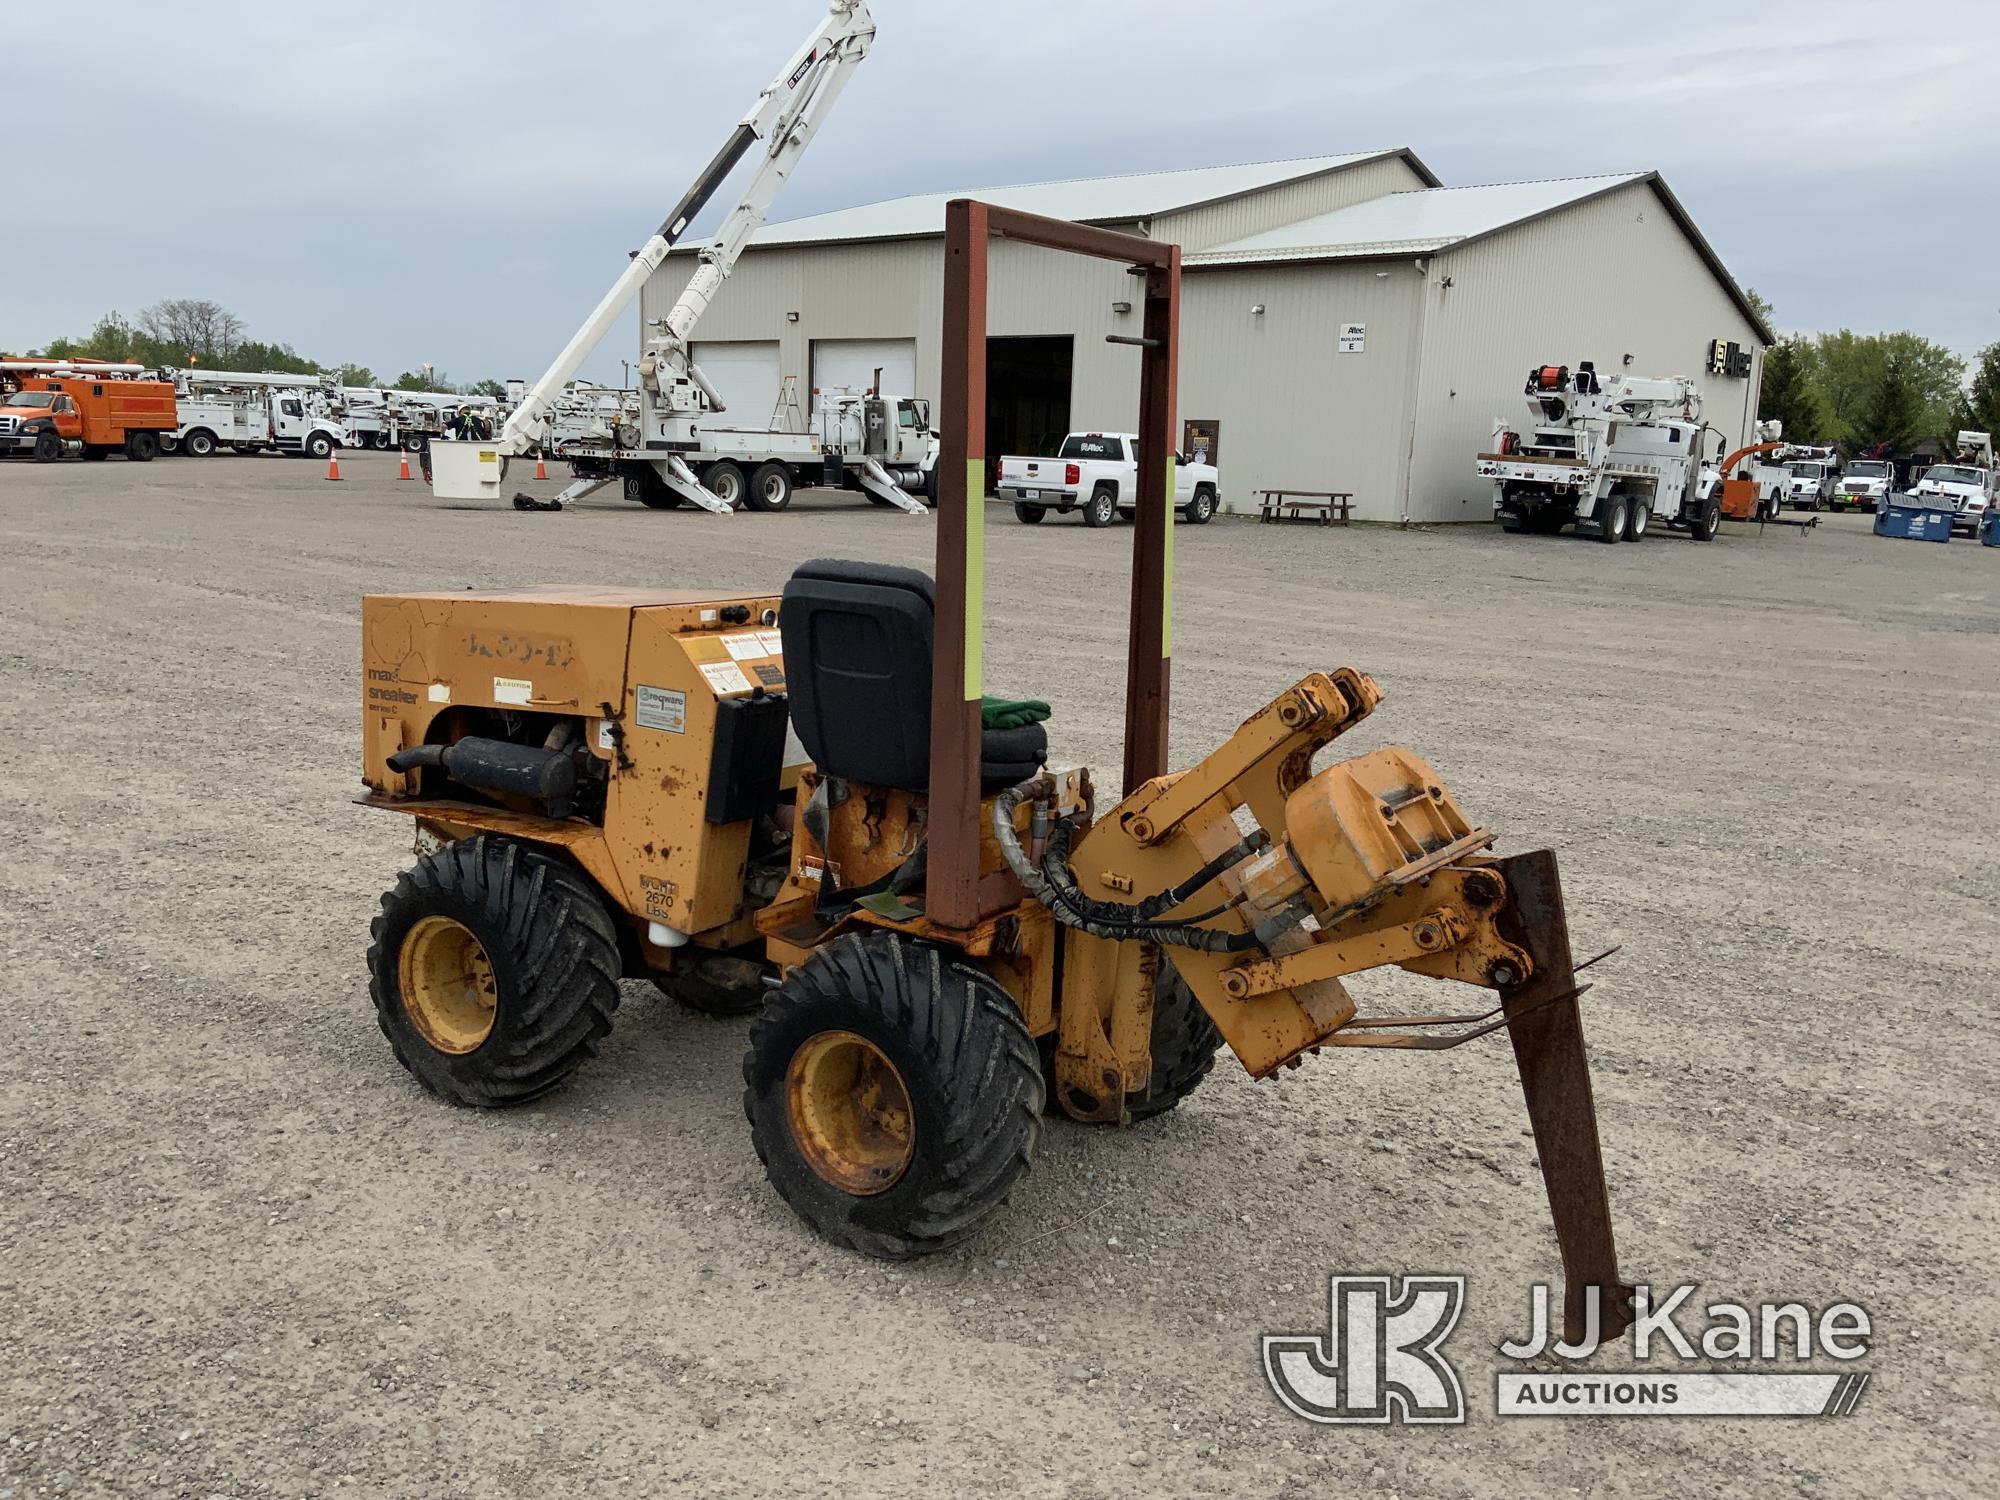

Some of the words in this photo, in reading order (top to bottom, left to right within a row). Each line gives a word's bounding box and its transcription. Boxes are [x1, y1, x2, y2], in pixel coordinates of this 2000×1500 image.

[793, 60, 810, 80] TEREX
[1726, 341, 1751, 378] Altec
[1088, 443, 1104, 452] Altec
[502, 681, 531, 689] CAUTION
[368, 687, 418, 704] sneaker
[646, 890, 673, 907] 2670
